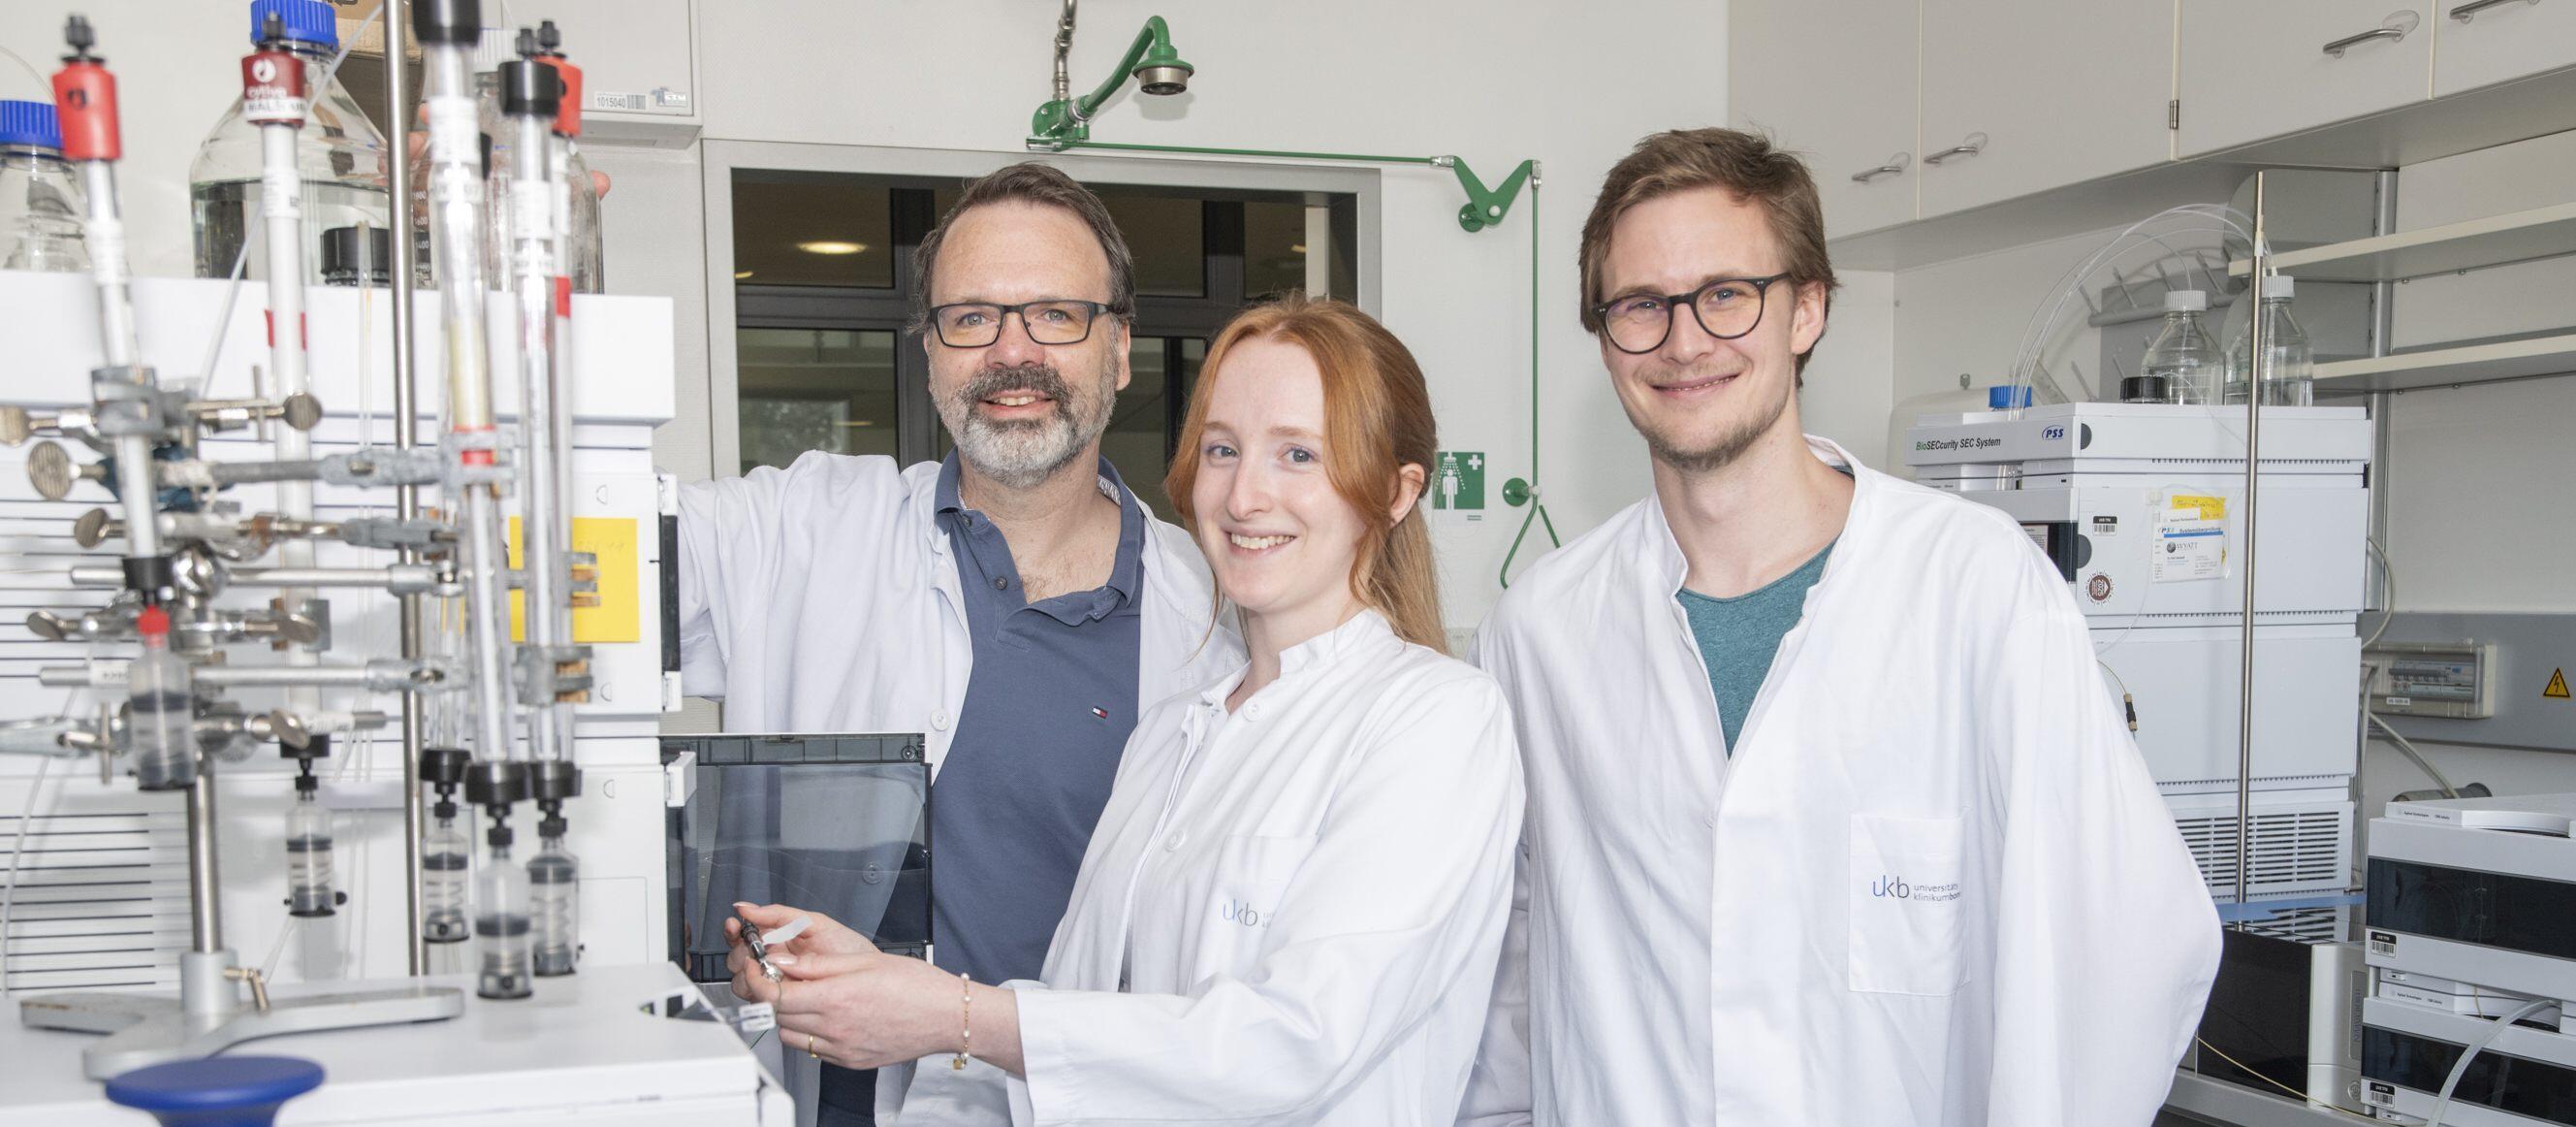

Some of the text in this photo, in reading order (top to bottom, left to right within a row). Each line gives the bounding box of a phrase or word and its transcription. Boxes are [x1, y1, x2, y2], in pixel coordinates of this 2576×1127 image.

[596, 96, 626, 109] 1015040
[2045, 428, 2064, 438] PSS
[1916, 436, 2001, 451] BioSECcurity SEC System
[1873, 874, 1910, 899] ukb
[1223, 897, 1258, 927] ukb
